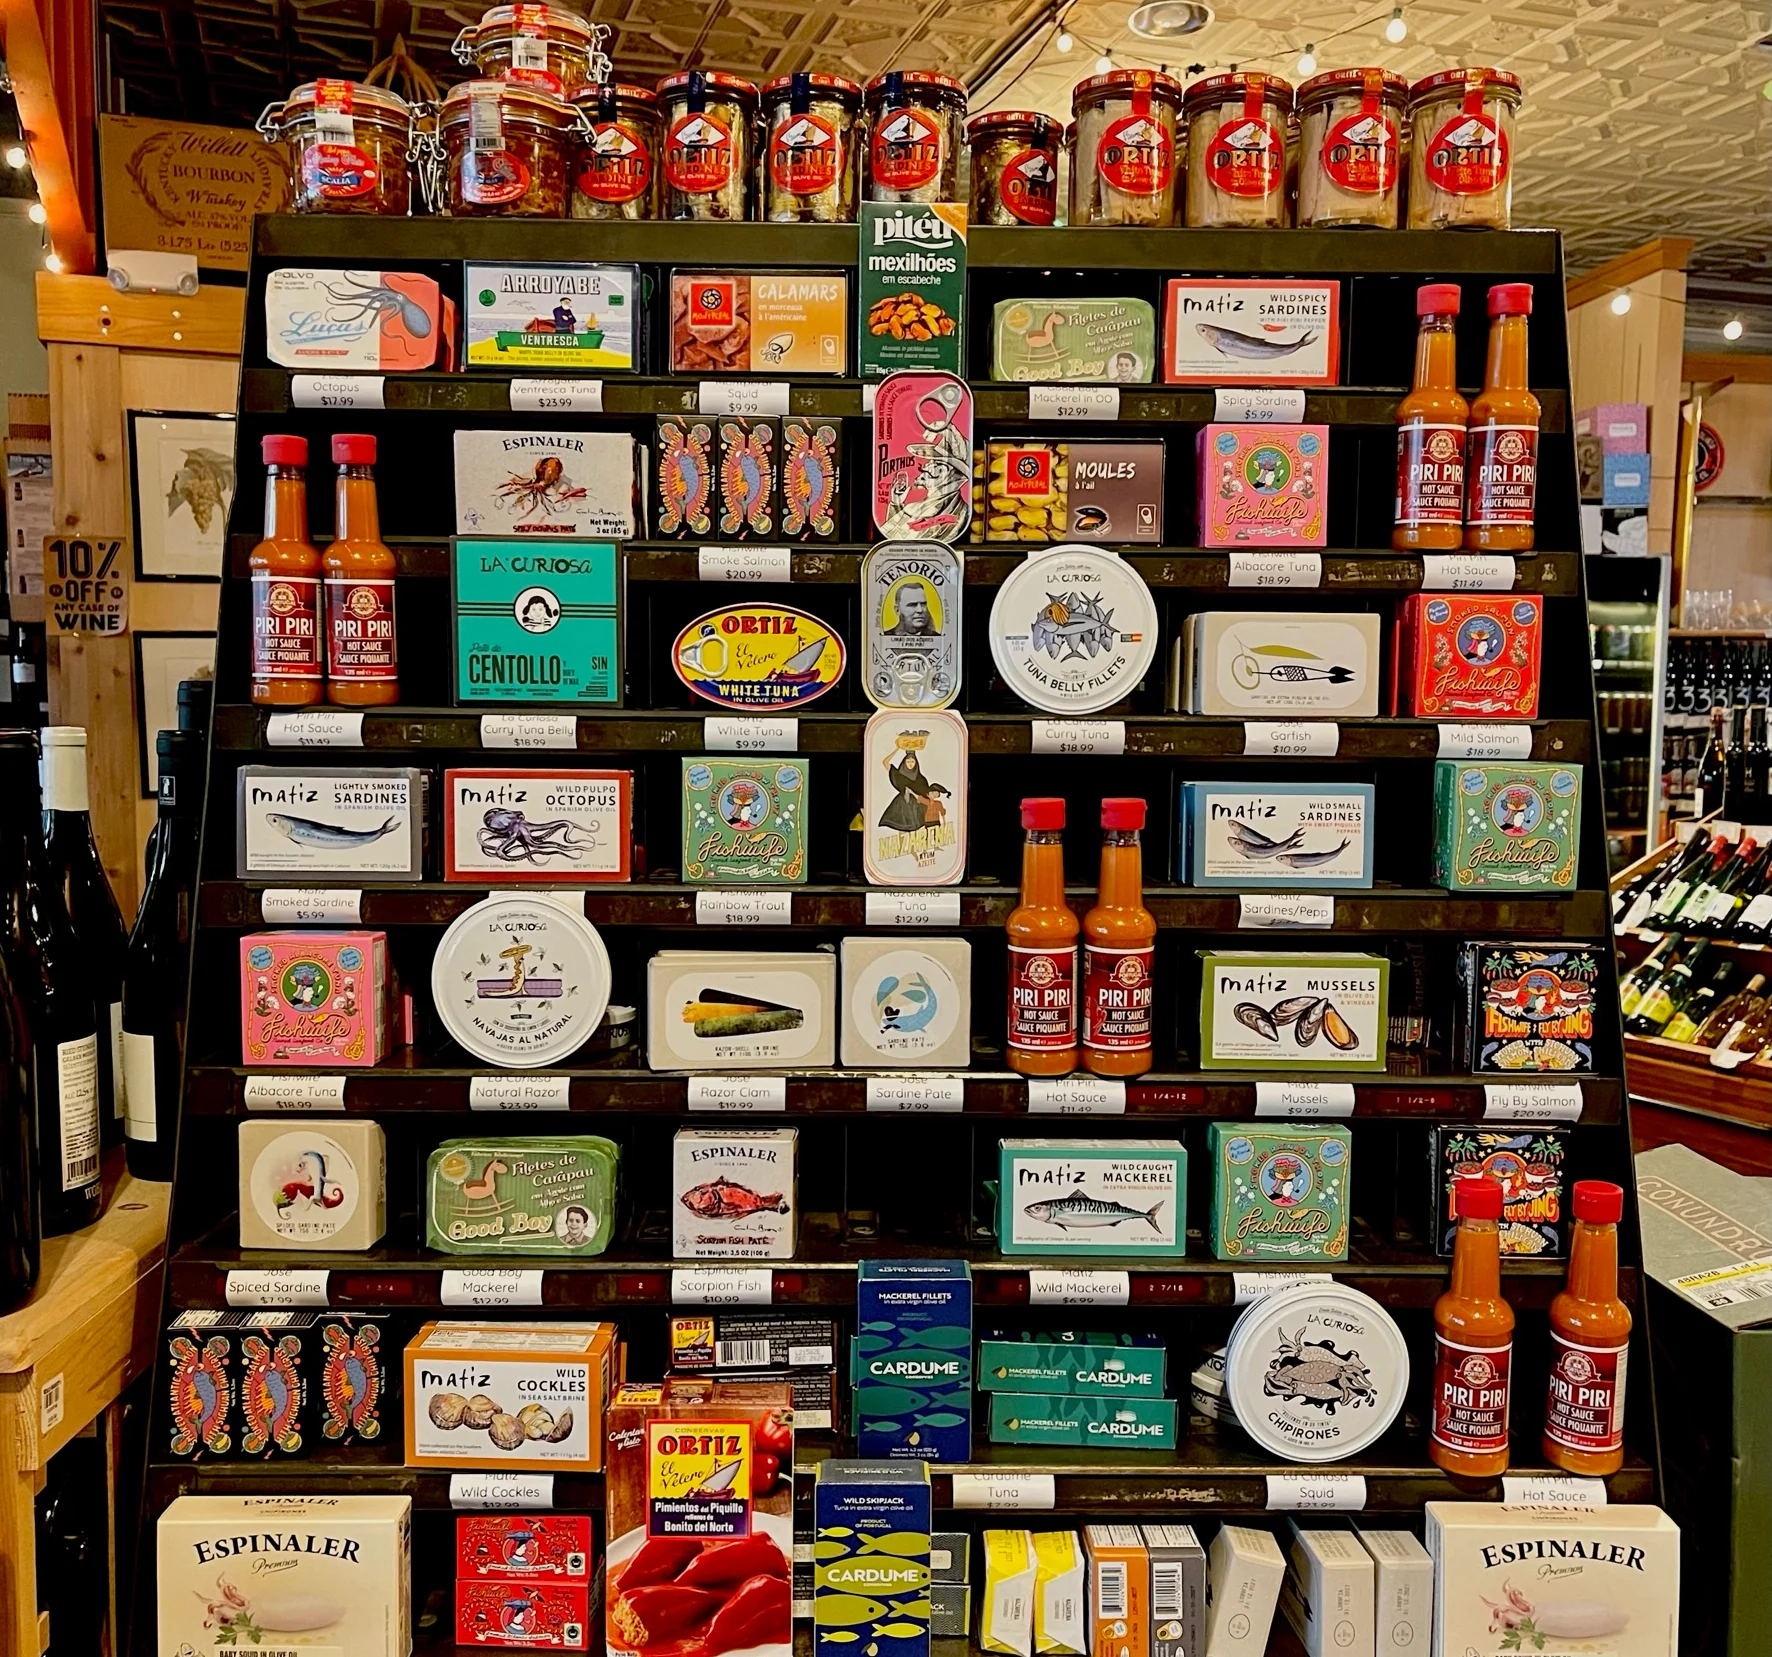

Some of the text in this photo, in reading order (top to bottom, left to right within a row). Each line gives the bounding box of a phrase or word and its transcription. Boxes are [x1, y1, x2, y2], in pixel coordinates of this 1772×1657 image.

[173, 164, 255, 184] BOURBON
[321, 175, 351, 185] SCALIA
[868, 252, 957, 273] mexilhões
[274, 271, 315, 280] POLVO
[882, 274, 941, 286] em escabeche
[501, 273, 601, 296] ARROYABE
[758, 283, 838, 302] CALAMARS
[1270, 294, 1328, 302] WILD SPICY
[1183, 293, 1245, 314] matiz
[1259, 303, 1328, 316] SARDINES
[521, 334, 580, 347] VENTRESCA
[312, 381, 360, 393] Octopus
[513, 385, 597, 396] Ventresca Tuna
[728, 389, 758, 400] Squid
[1034, 392, 1081, 404] Mackerel
[1084, 393, 1093, 404] in
[1223, 394, 1297, 408] Spicy Sardine
[321, 396, 354, 407] $17.99
[538, 397, 572, 408] $23.99
[729, 402, 758, 413] $9.99
[1057, 406, 1088, 417] $12.99
[1244, 409, 1274, 421] $5.99
[502, 435, 585, 455] ESPINALER
[1075, 462, 1136, 479] MOULES
[1480, 464, 1535, 482] PIRI PIRI
[1491, 485, 1525, 496] HOT SAUCE
[48, 539, 121, 579] 10%
[702, 556, 786, 567] Smoke Salmon
[1234, 561, 1316, 573] Albacore Tuna
[1441, 564, 1498, 576] Hot Sauce
[725, 569, 762, 581] $20.99
[879, 560, 945, 588] TENORIO
[1256, 576, 1291, 586] $18.99
[1452, 578, 1483, 590] $11.49
[65, 580, 107, 602] OFF
[54, 604, 120, 612] ANY CASE OF
[55, 613, 119, 632] WINE
[256, 616, 314, 636] PIRI PIRI
[722, 615, 798, 636] ORTIZ
[265, 638, 301, 650] HOT SAUCE
[258, 650, 310, 662] SAUCE PIQUANTE
[469, 655, 563, 685] CENTOLLO
[591, 656, 609, 671] SIN
[1022, 655, 1127, 693] TUNA BELLY FILLETS
[1435, 666, 1522, 696] Fishwife
[718, 685, 799, 698] WHITE TUNA
[484, 725, 574, 738] Curry Tuna Belly
[718, 726, 783, 737] White Tuna
[1046, 729, 1110, 742] Curry Tuna
[735, 739, 765, 750] $9.99
[1451, 732, 1520, 745] Mild Salmon
[1060, 742, 1094, 753] $18.99
[334, 783, 408, 791] LIGHTLY SMOKED
[252, 782, 319, 806] matiz
[334, 792, 408, 804] SARDINES
[546, 795, 617, 807] OCTOPUS
[878, 821, 957, 862] NAZARENA
[266, 897, 355, 909] Smoked Sardine
[700, 899, 786, 911] Rainbow Trout
[898, 900, 927, 912] Tuna
[1244, 903, 1329, 919] Sardines/Pepp
[725, 913, 760, 924] $18.99
[894, 914, 929, 925] $12.99
[1307, 980, 1376, 992] MUSSELS
[1013, 988, 1071, 1006] PIRI PIRI
[472, 1012, 573, 1044] NAVAJAS AL NATURAL
[1563, 1012, 1591, 1035] JING
[249, 1085, 338, 1098] Albacore Tuna
[475, 1086, 561, 1098] Natural Razor
[701, 1087, 771, 1099] Razor Clam
[876, 1087, 952, 1099] Sardine Pate
[1282, 1093, 1329, 1106] Mussels
[1491, 1094, 1576, 1107] Fly By Salmon
[1019, 1163, 1087, 1187] matiz
[1103, 1172, 1173, 1184] MACKEREL
[1236, 1207, 1331, 1239] Fishwife
[229, 1280, 321, 1295] Spiced Sardine
[462, 1281, 518, 1294] Mackerel
[680, 1279, 762, 1293] Scorpion Fish
[1036, 1282, 1122, 1294] Wild Mackerel
[870, 1361, 960, 1376] CARDUME
[421, 1367, 491, 1390] matiz
[517, 1380, 586, 1392] COCKLES
[1268, 1411, 1341, 1440] CHIPIRONES
[657, 1435, 743, 1456] ORTIZ
[461, 1486, 540, 1498] Wild Cockles
[988, 1487, 1019, 1498] Tuna
[1299, 1486, 1335, 1500] Squid
[655, 1502, 700, 1513] Pimientos
[710, 1501, 744, 1515] Piquillo
[843, 1497, 904, 1506] WILD SKIPJACK
[664, 1521, 735, 1533] Bonito del Norte
[192, 1533, 361, 1565] ESPINALER
[1480, 1539, 1646, 1572] ESPINALER
[827, 1568, 919, 1583] CARDUME
